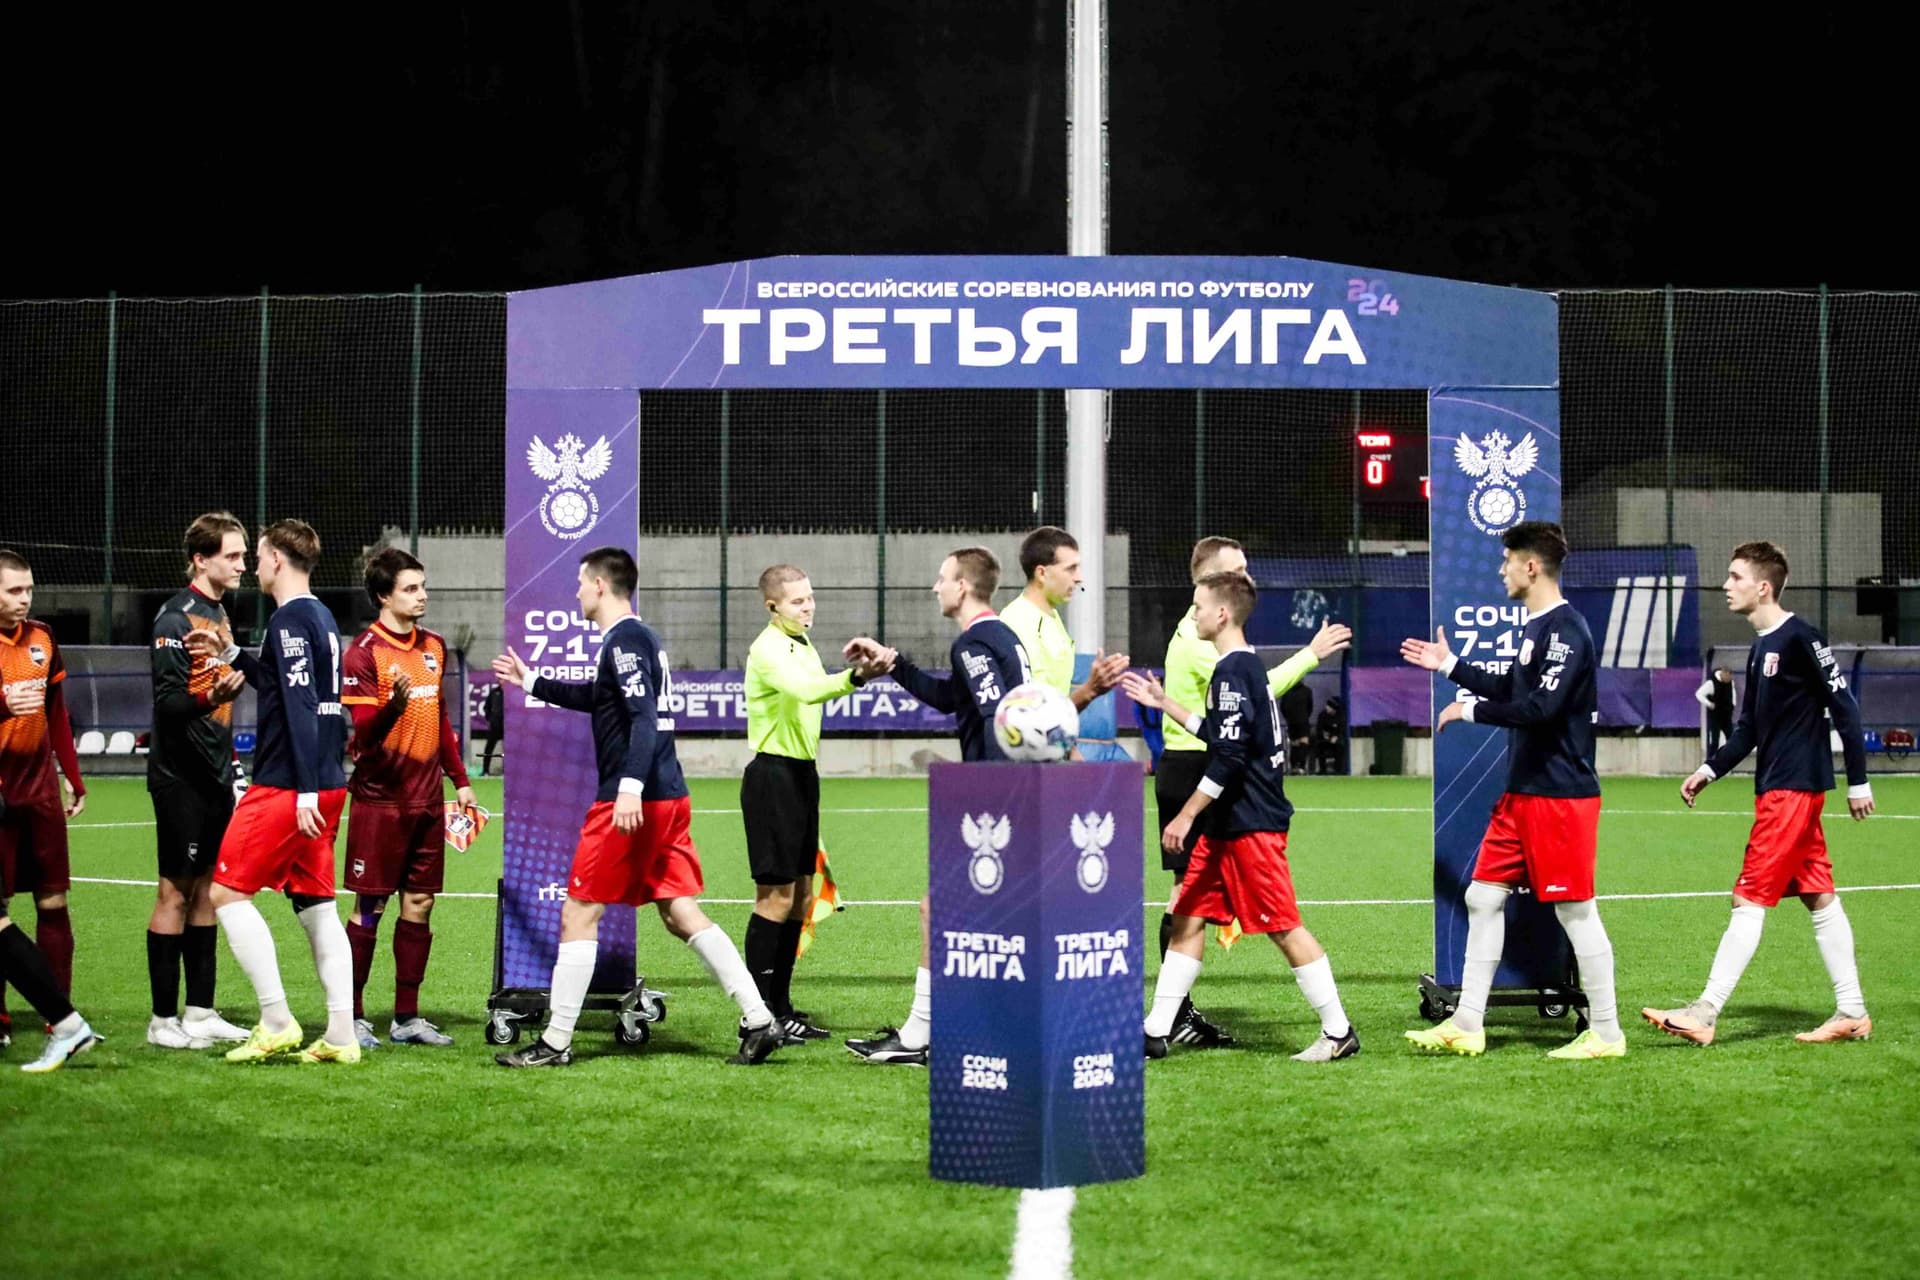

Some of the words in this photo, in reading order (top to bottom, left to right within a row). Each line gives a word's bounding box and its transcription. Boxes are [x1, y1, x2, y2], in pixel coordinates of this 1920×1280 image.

[757, 278, 959, 298] ВСЕРОССИЙСКИЕ
[963, 281, 1156, 298] СОРЕВНОВАНИЯ
[1161, 281, 1194, 298] ПО
[1199, 280, 1314, 299] ФУТБОЛУ
[703, 306, 1078, 367] ТРЕТЬЯ
[1120, 308, 1367, 365] ЛИГА
[1367, 460, 1383, 484] 0
[944, 931, 1025, 955] ТРЕТЬЯ
[1055, 929, 1129, 953] ТРЕТЬЯ
[944, 951, 1025, 982] ЛИГА
[1055, 950, 1129, 981] ЛИГА
[962, 1054, 1008, 1072] СОЧИ
[1073, 1053, 1114, 1070] СОЧИ
[962, 1069, 1008, 1090] 2024
[1073, 1067, 1114, 1089] 2024
